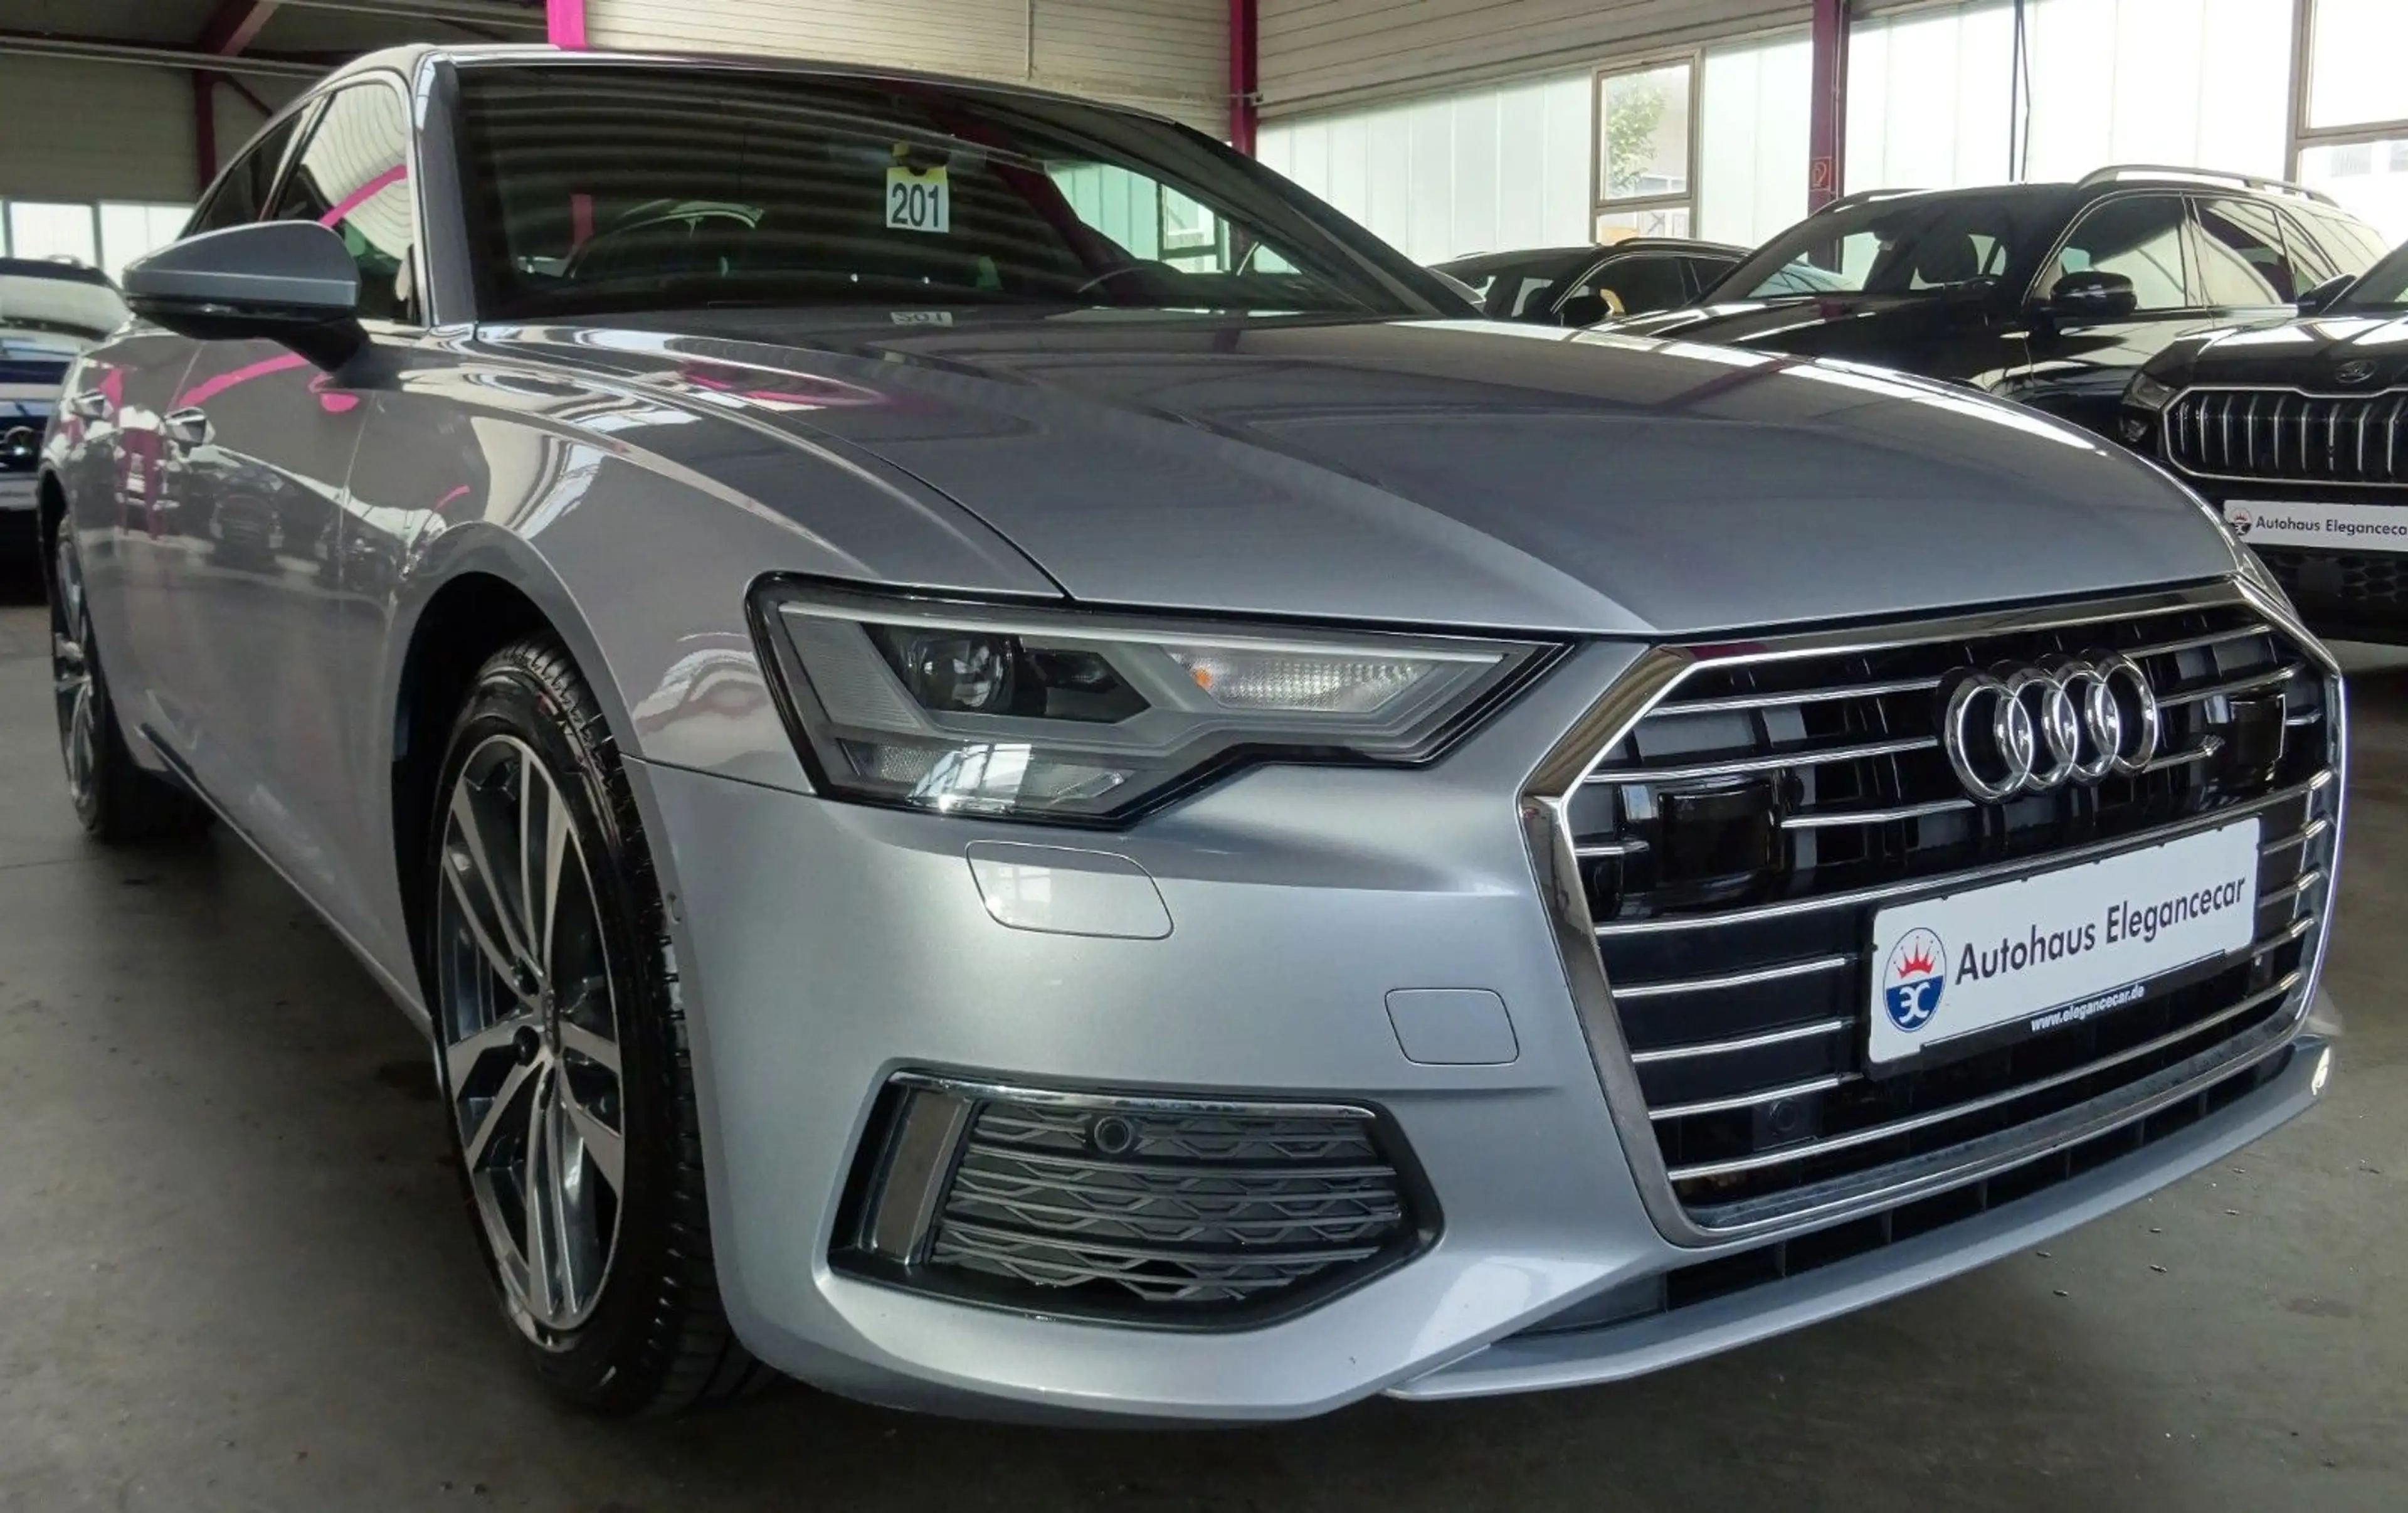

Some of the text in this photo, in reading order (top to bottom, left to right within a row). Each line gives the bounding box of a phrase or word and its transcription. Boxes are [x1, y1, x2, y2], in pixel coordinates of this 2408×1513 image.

[892, 183, 939, 228] 201
[2256, 516, 2320, 531] Autohaus
[1956, 877, 2245, 985] Autohaus Elegancecar
[2031, 983, 2145, 1032] www.elegancecar.de
